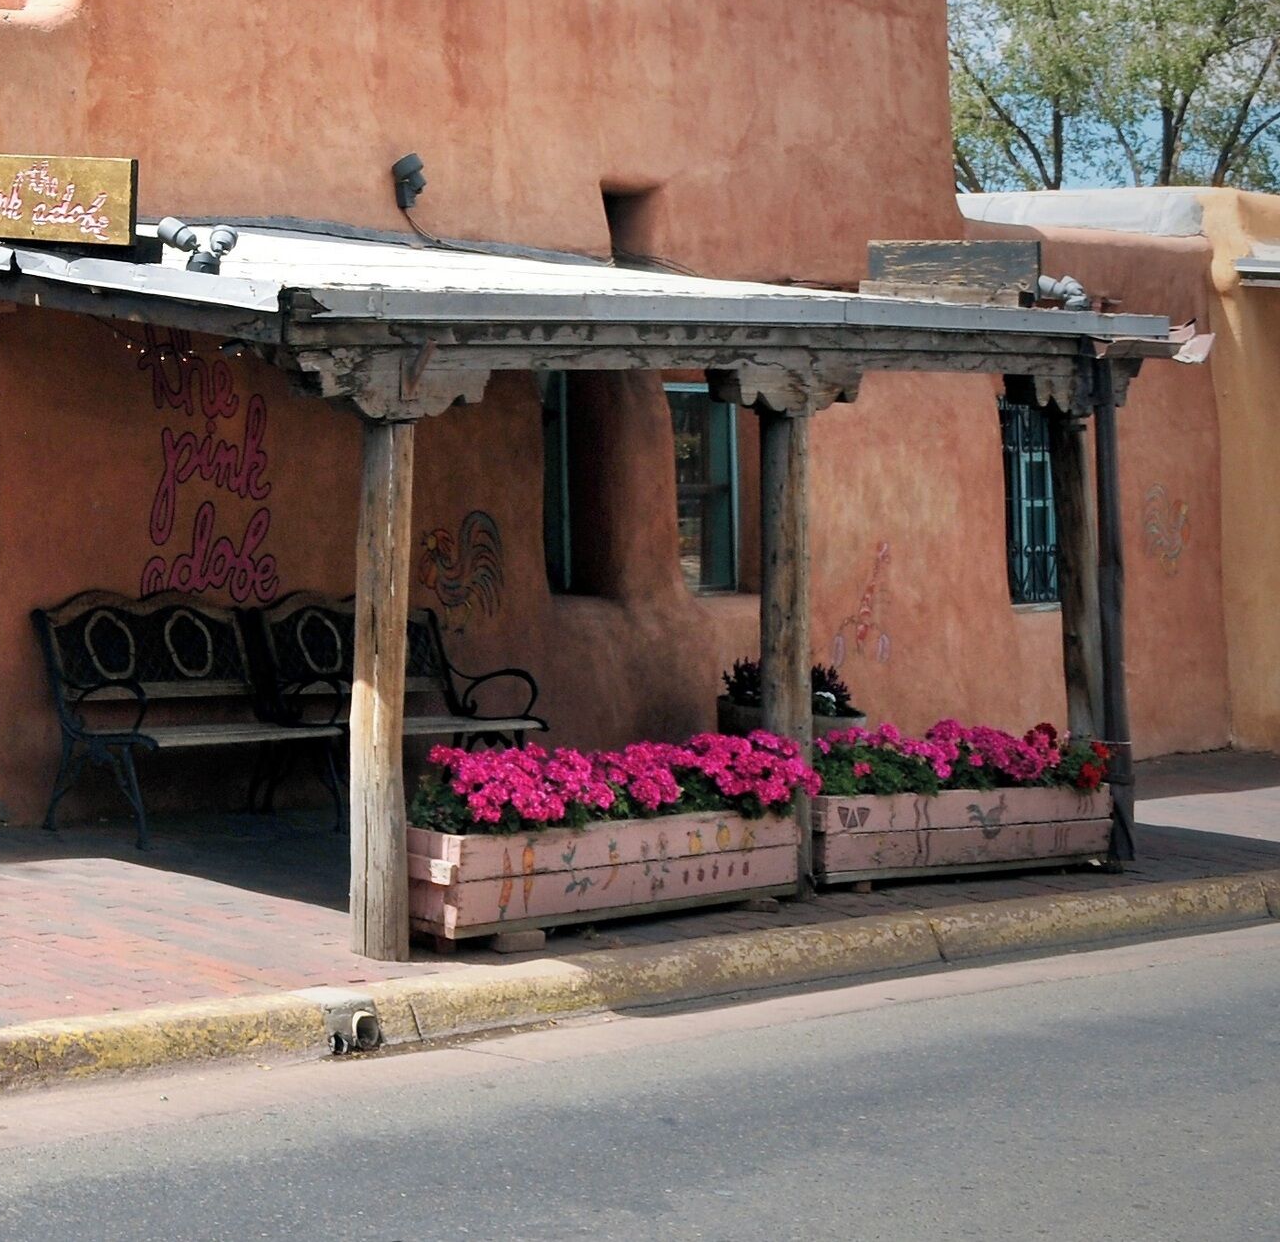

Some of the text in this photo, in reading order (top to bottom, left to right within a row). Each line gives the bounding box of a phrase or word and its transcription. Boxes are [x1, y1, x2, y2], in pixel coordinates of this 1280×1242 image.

[24, 160, 58, 197] the
[31, 183, 110, 241] adobe
[137, 324, 240, 419] the
[150, 394, 271, 545] pink
[140, 500, 279, 603] adobe
